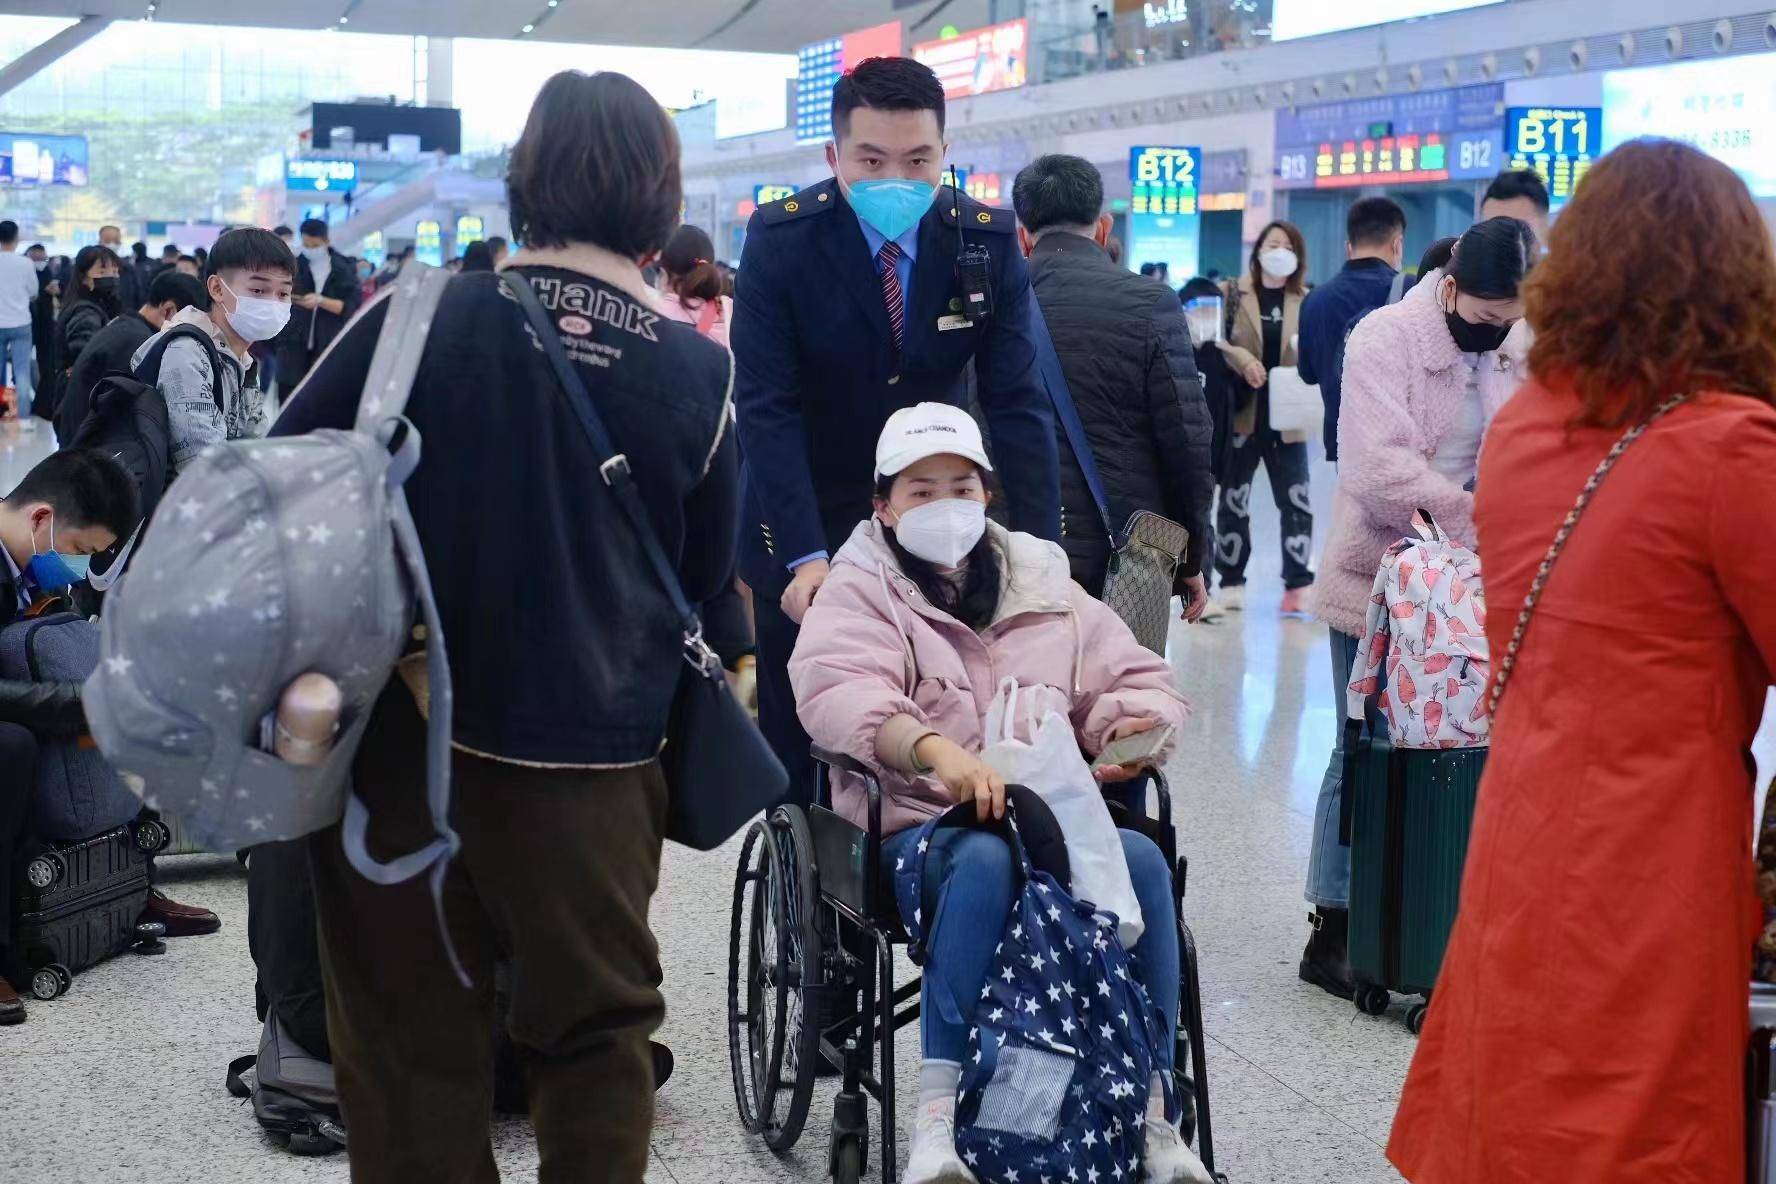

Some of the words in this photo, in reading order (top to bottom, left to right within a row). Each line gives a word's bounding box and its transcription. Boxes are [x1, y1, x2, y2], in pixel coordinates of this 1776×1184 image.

[1518, 118, 1587, 153] B11
[1137, 154, 1195, 181] B12
[1281, 154, 1307, 179] B13
[1460, 140, 1492, 168] B12
